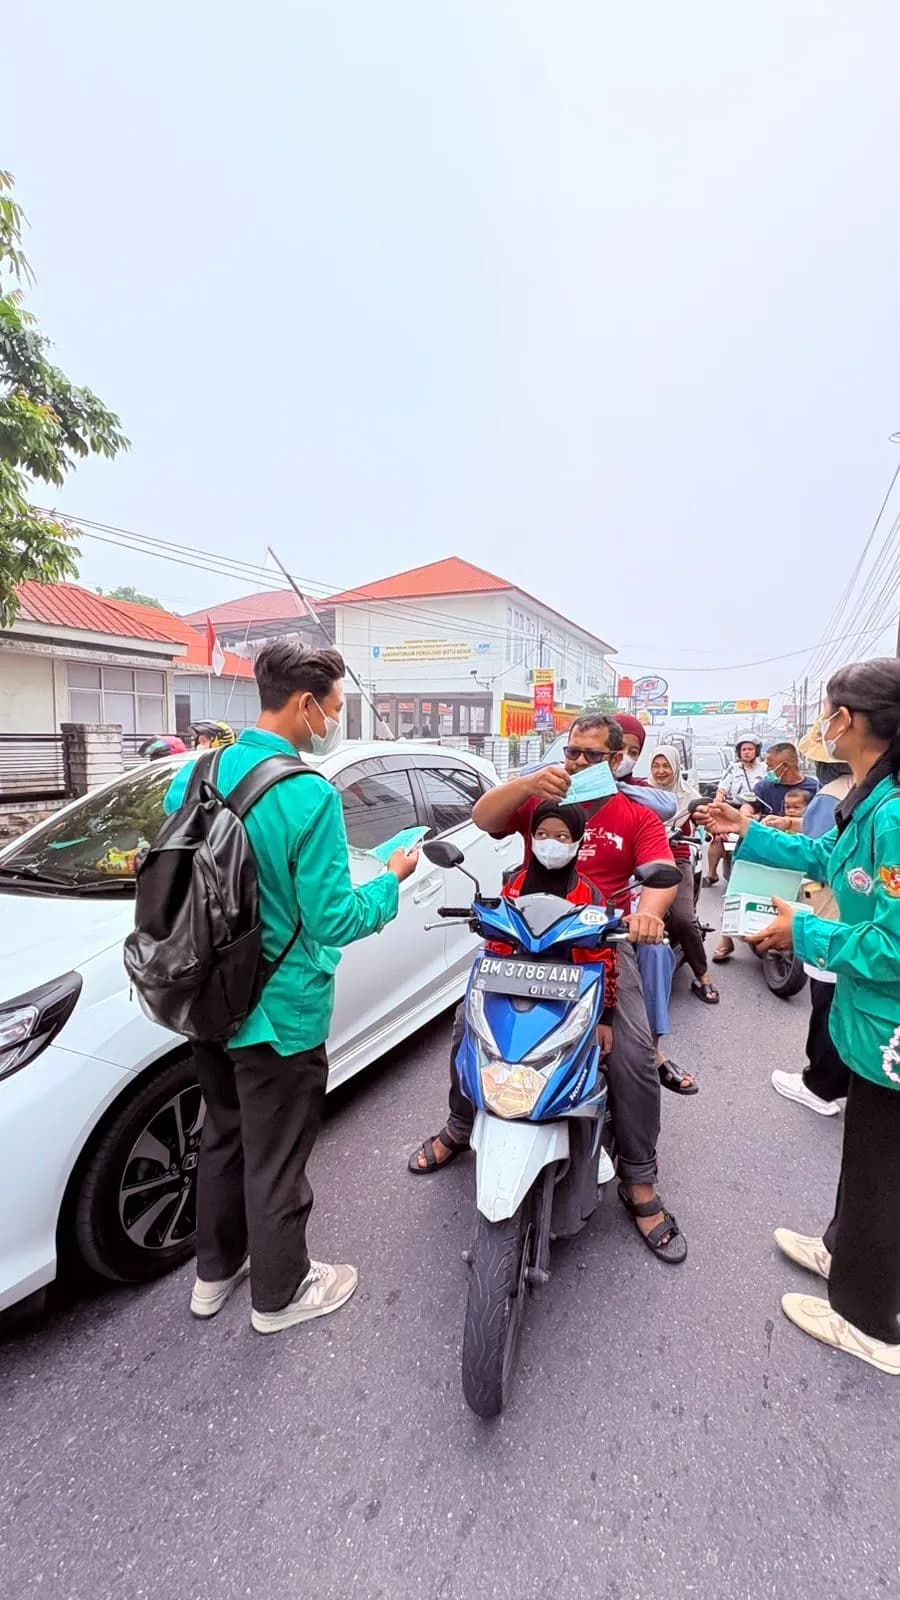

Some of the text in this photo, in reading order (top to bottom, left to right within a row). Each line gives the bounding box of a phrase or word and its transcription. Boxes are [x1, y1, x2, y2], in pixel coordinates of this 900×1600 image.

[480, 958, 580, 984] BM 3786 AAN
